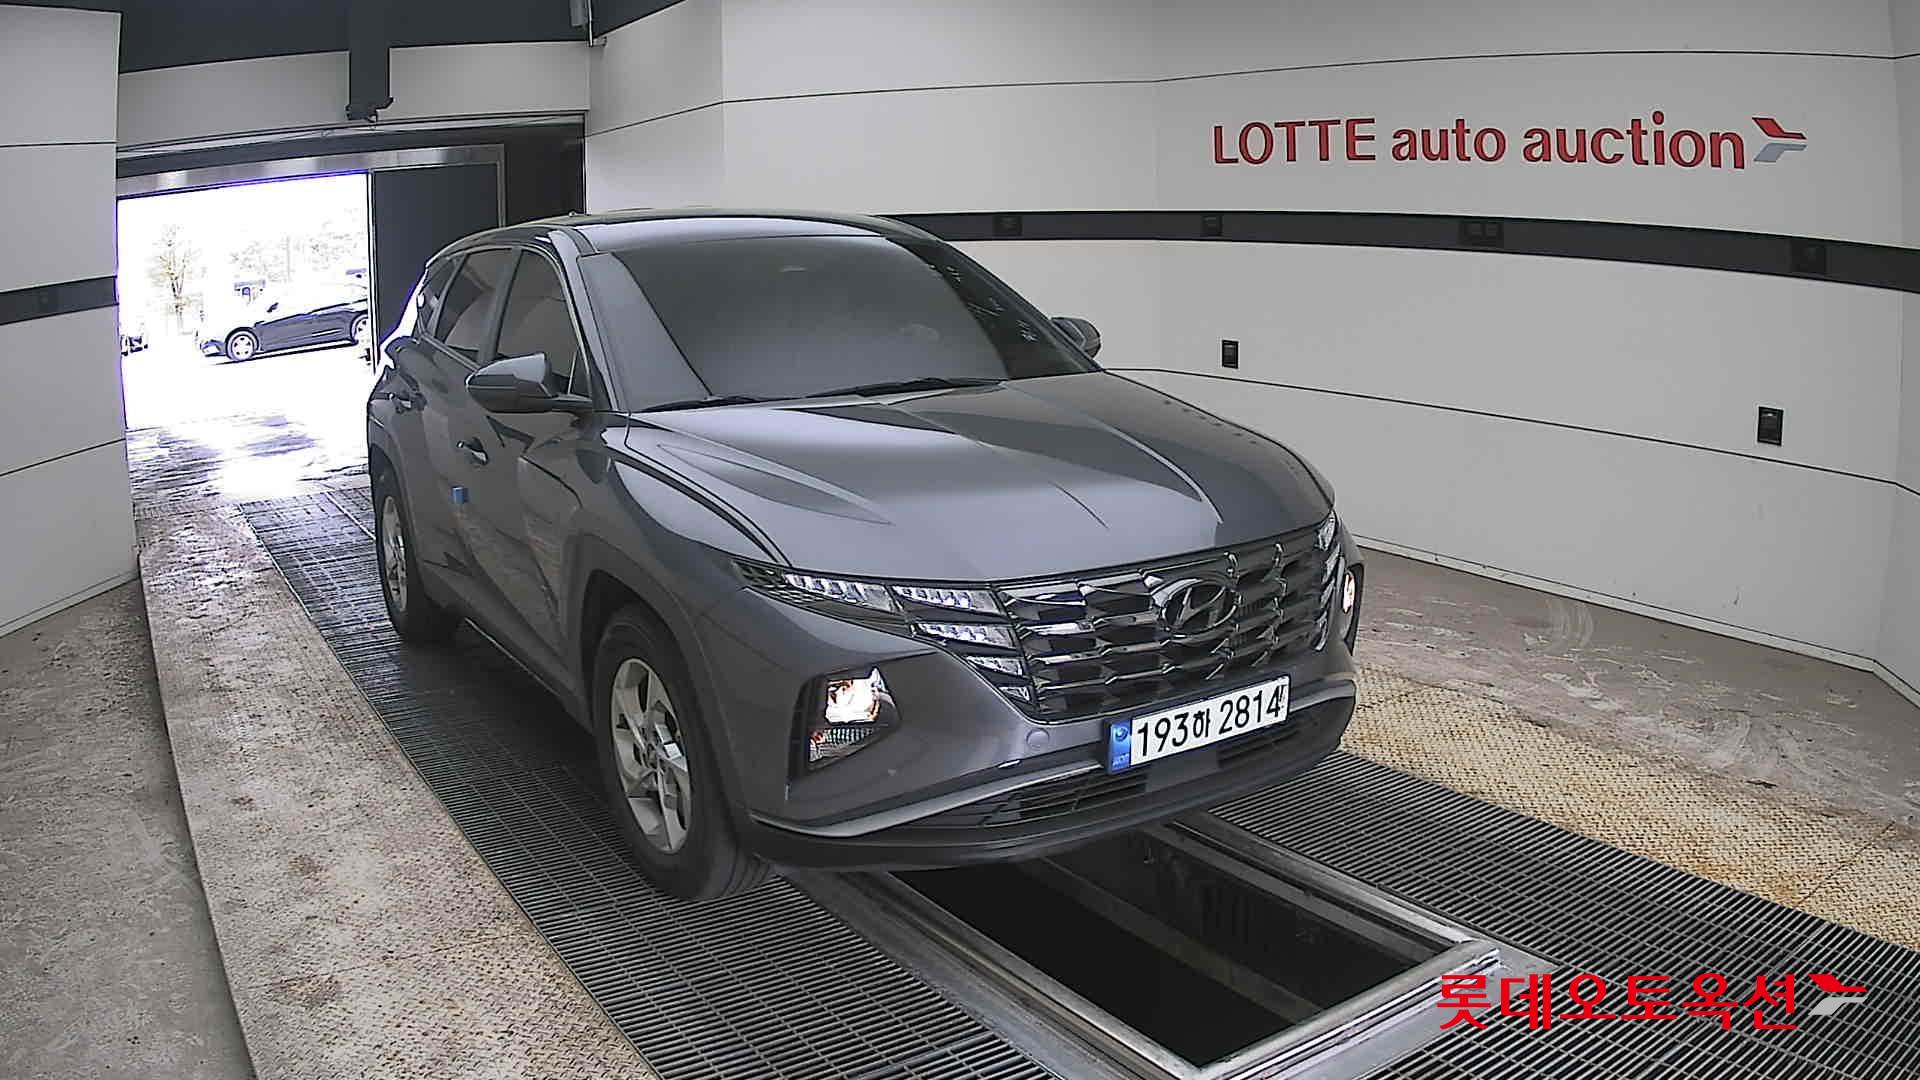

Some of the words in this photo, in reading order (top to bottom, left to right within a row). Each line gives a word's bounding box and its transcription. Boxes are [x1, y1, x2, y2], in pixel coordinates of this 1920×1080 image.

[1213, 118, 1376, 165] LOTTE
[1391, 118, 1506, 162] auto
[1522, 110, 1745, 169] auction
[1137, 708, 1211, 757] 193하
[1218, 685, 1282, 735] 2814
